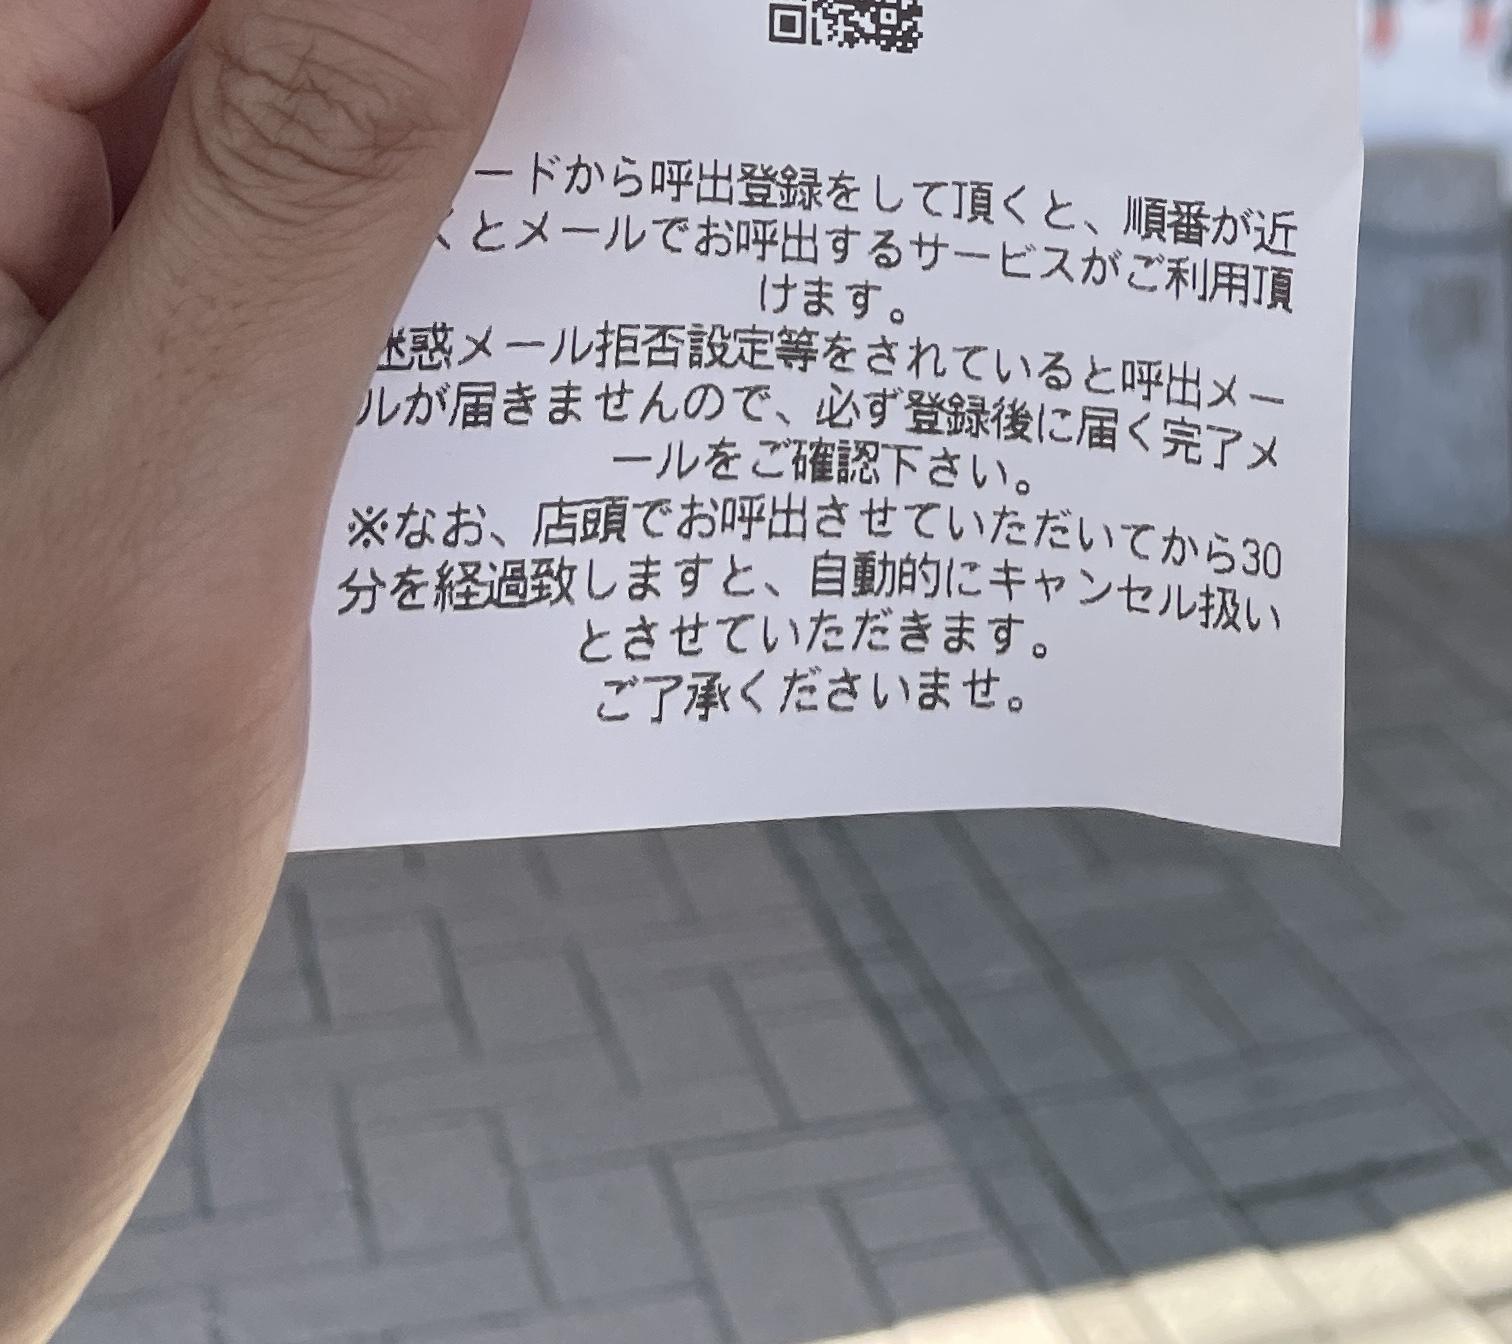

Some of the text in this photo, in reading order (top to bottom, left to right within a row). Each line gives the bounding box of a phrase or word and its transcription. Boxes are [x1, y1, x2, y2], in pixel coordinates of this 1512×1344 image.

[758, 272, 907, 327] けます。
[612, 435, 1032, 498] ールをご確認下さい。
[578, 607, 1050, 664] とさせていただきます。
[596, 665, 1025, 725] ご了承くださいませ。
